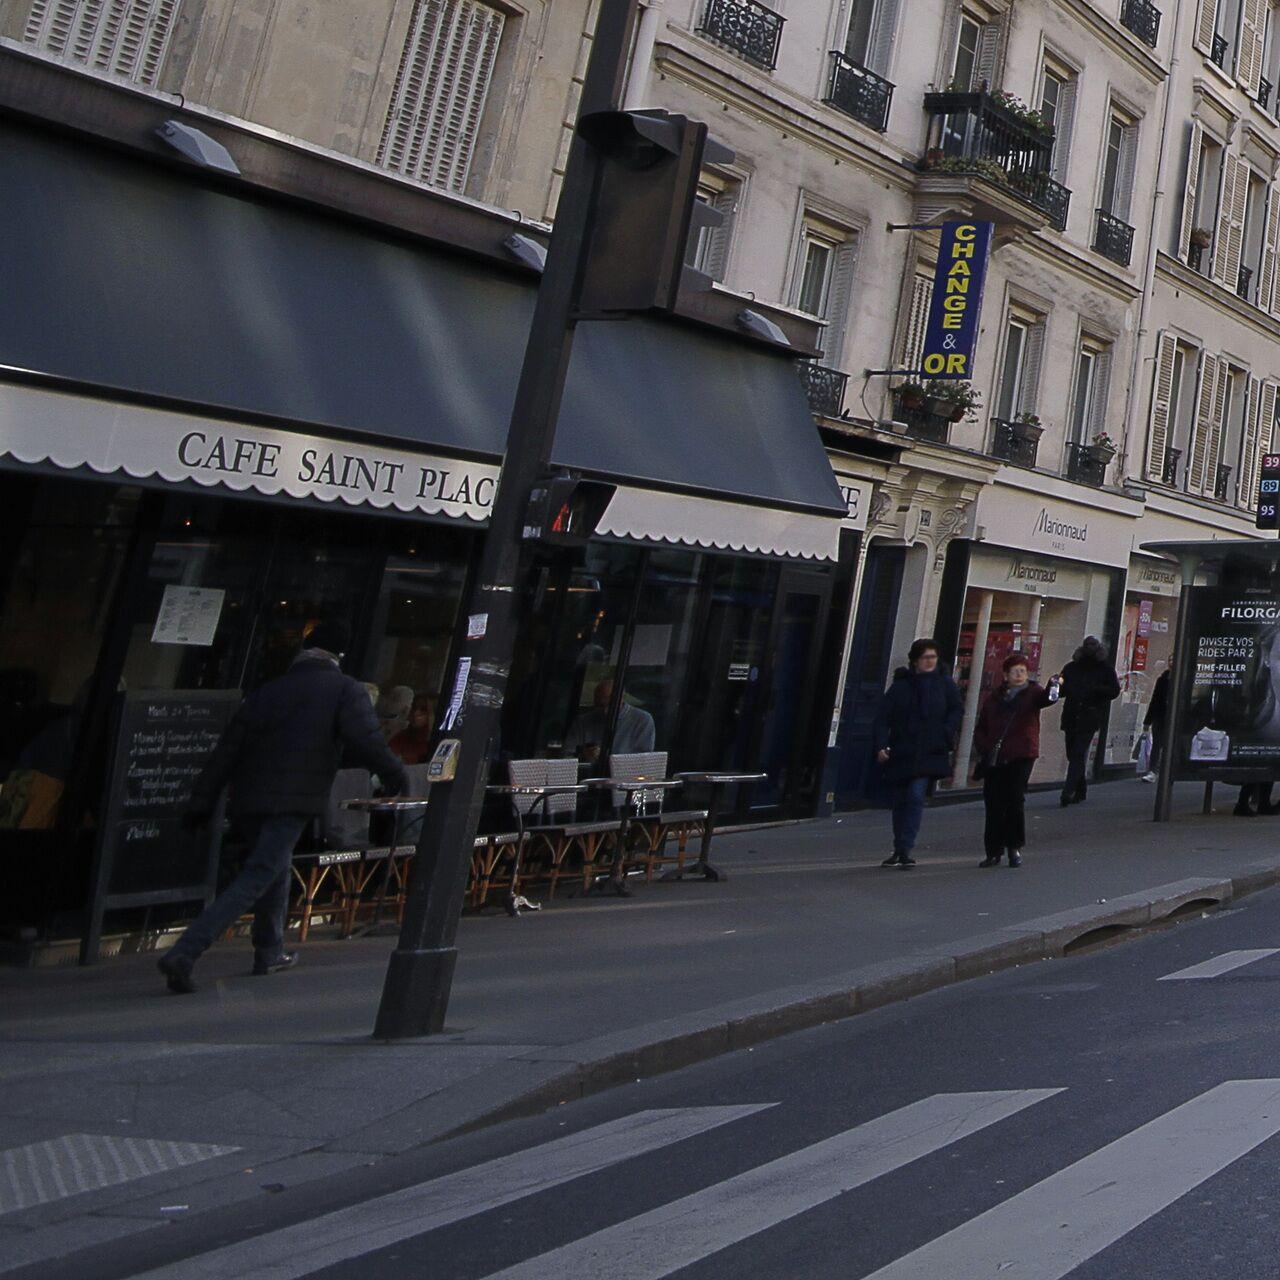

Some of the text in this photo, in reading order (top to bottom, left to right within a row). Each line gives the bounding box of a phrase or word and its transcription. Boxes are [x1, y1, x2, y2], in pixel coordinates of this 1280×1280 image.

[924, 225, 977, 374] CHANGE & OR
[1265, 457, 1280, 468] 39
[178, 432, 497, 507] CAFE SAINT PLAC
[1263, 481, 1277, 492] 89
[1261, 505, 1275, 516] 95
[1032, 508, 1087, 541] Marionnaud
[1007, 560, 1057, 584] Marionnaud
[1199, 637, 1254, 647] DIVISEZ VOS
[1198, 648, 1255, 658] RIDES PAR 2
[1197, 663, 1247, 672] TIME-FILLER
